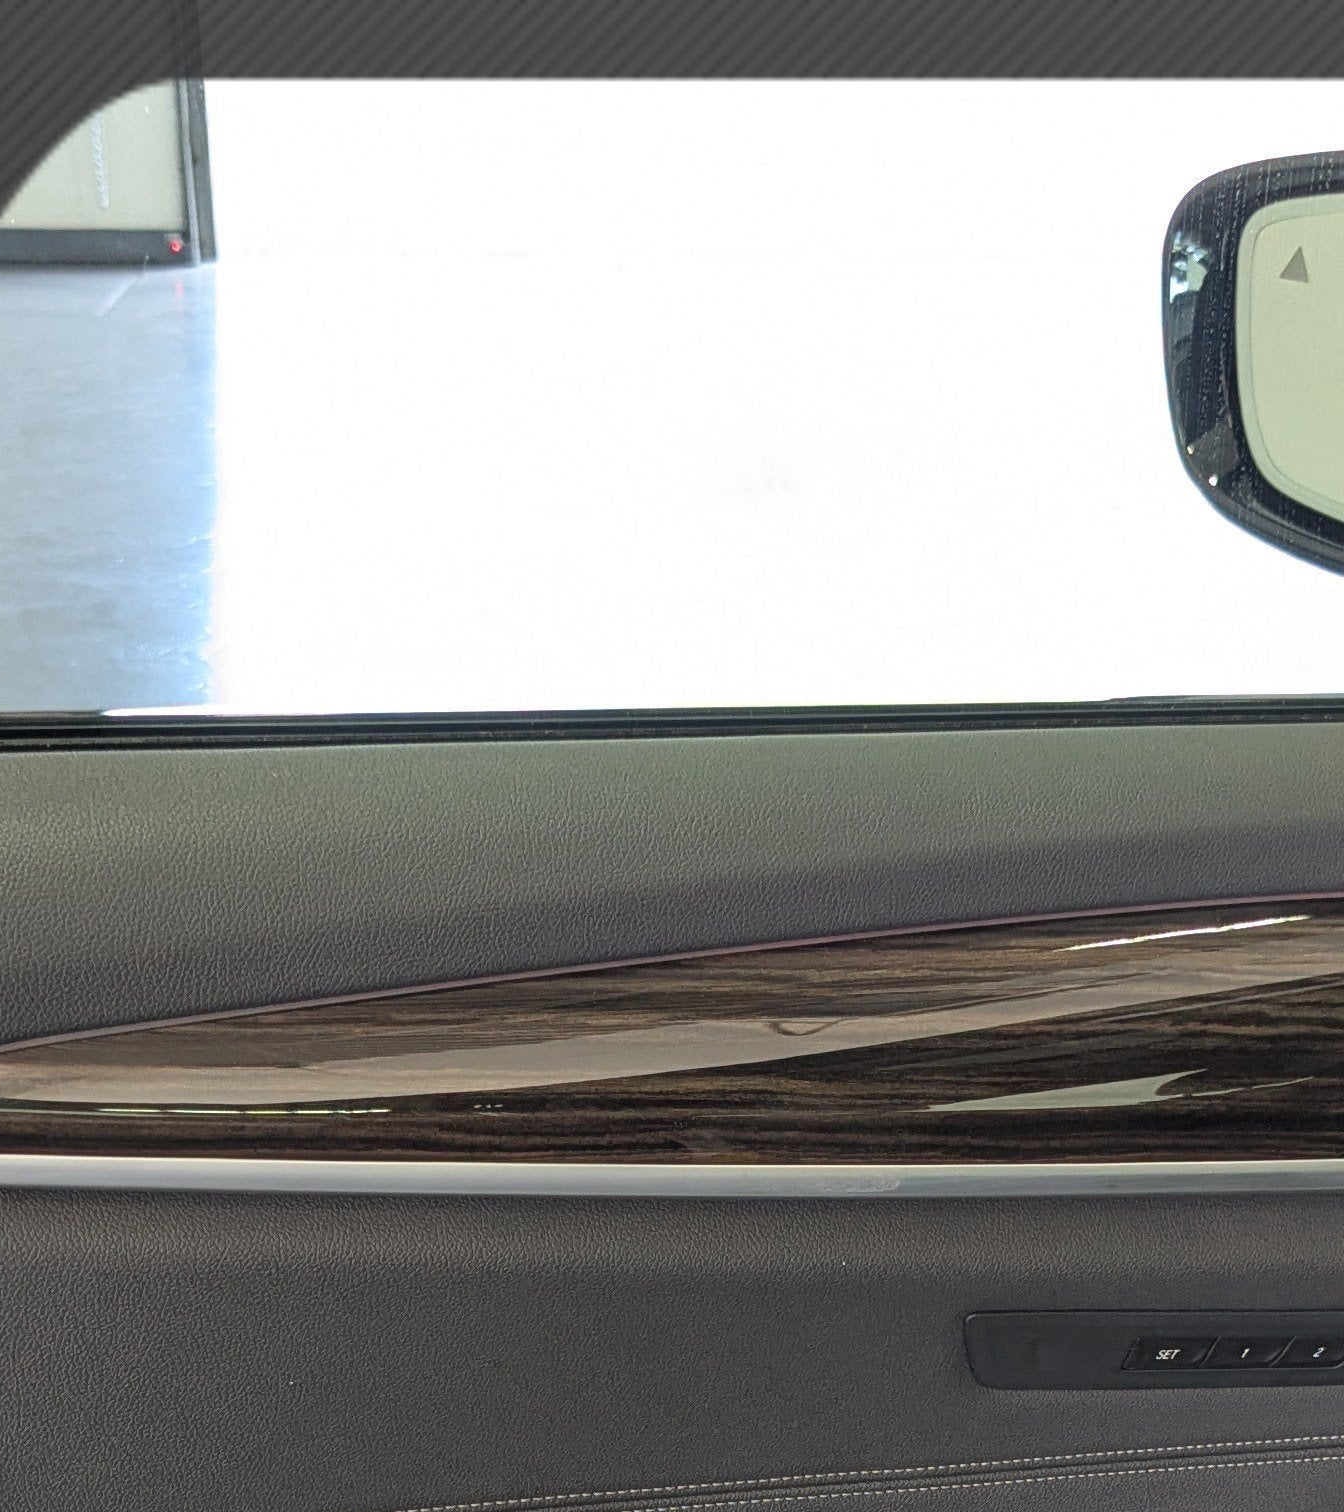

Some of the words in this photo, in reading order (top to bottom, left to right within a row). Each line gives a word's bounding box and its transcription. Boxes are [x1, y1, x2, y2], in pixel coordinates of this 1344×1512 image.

[1156, 1348, 1181, 1361] SET
[1241, 1347, 1250, 1359] 1
[1312, 1346, 1325, 1359] 2
